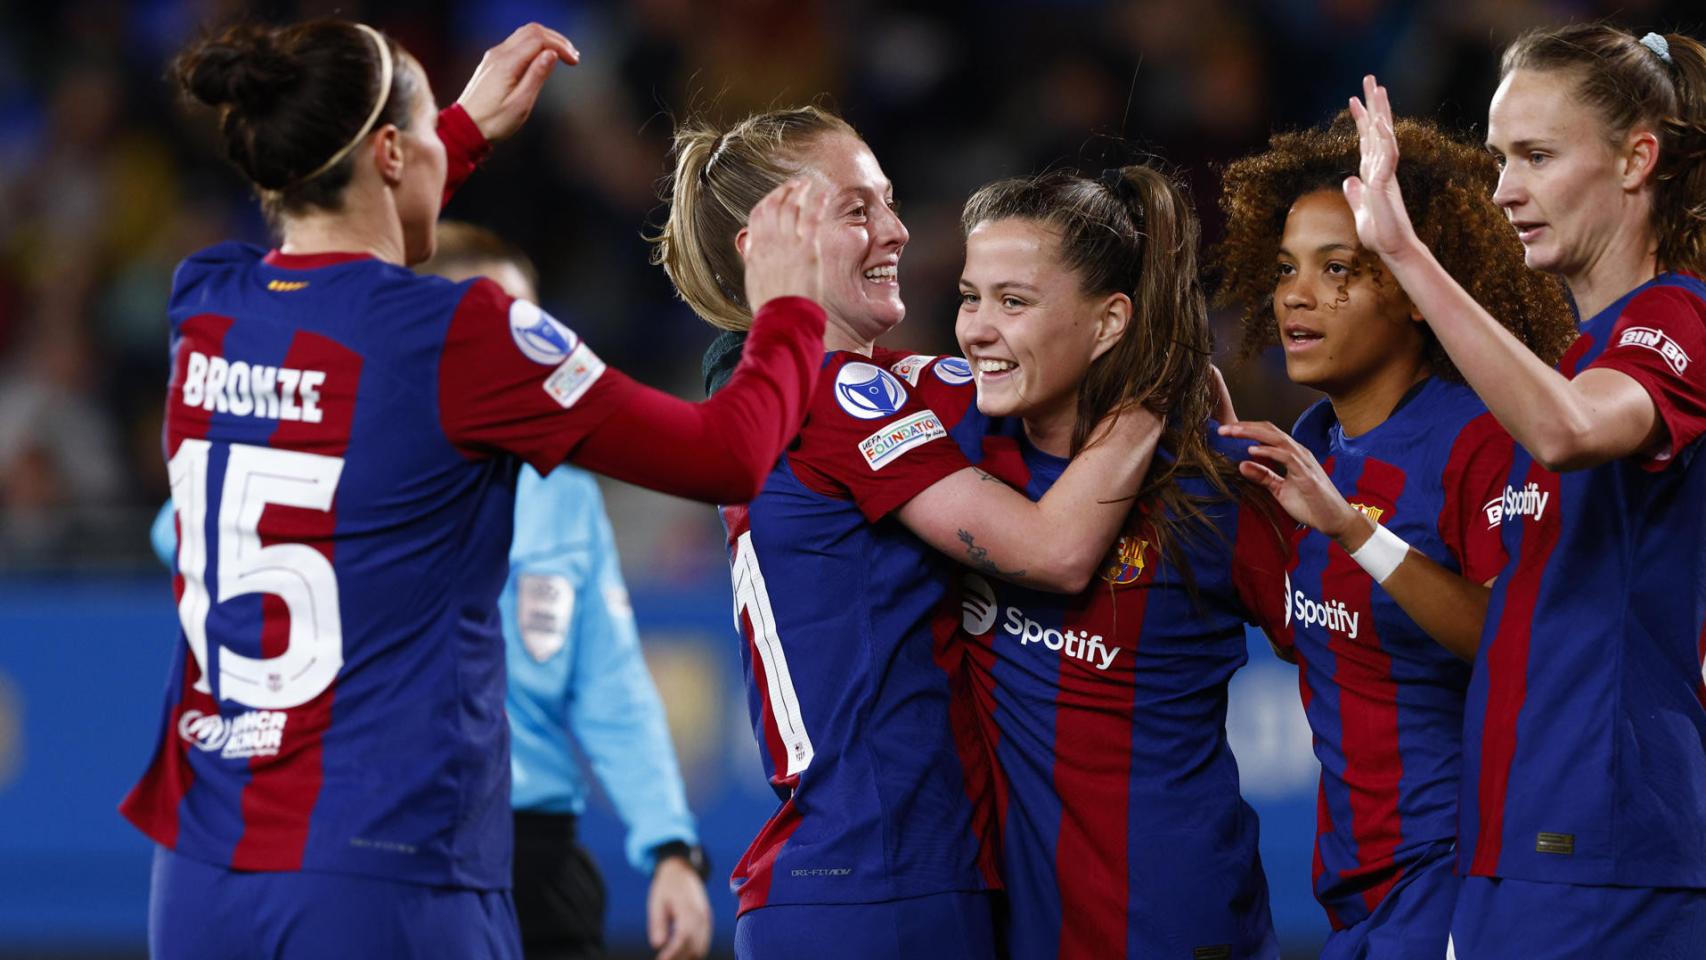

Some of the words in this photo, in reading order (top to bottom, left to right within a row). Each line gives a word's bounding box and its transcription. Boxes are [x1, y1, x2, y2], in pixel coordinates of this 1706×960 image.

[183, 352, 326, 423] BRONZE
[862, 435, 882, 450] UEFA
[866, 418, 941, 460] FOUNDATION
[1505, 482, 1549, 521] Spotify
[167, 438, 345, 709] 15
[1003, 606, 1121, 670] Spotify
[1295, 590, 1359, 639] Spotify
